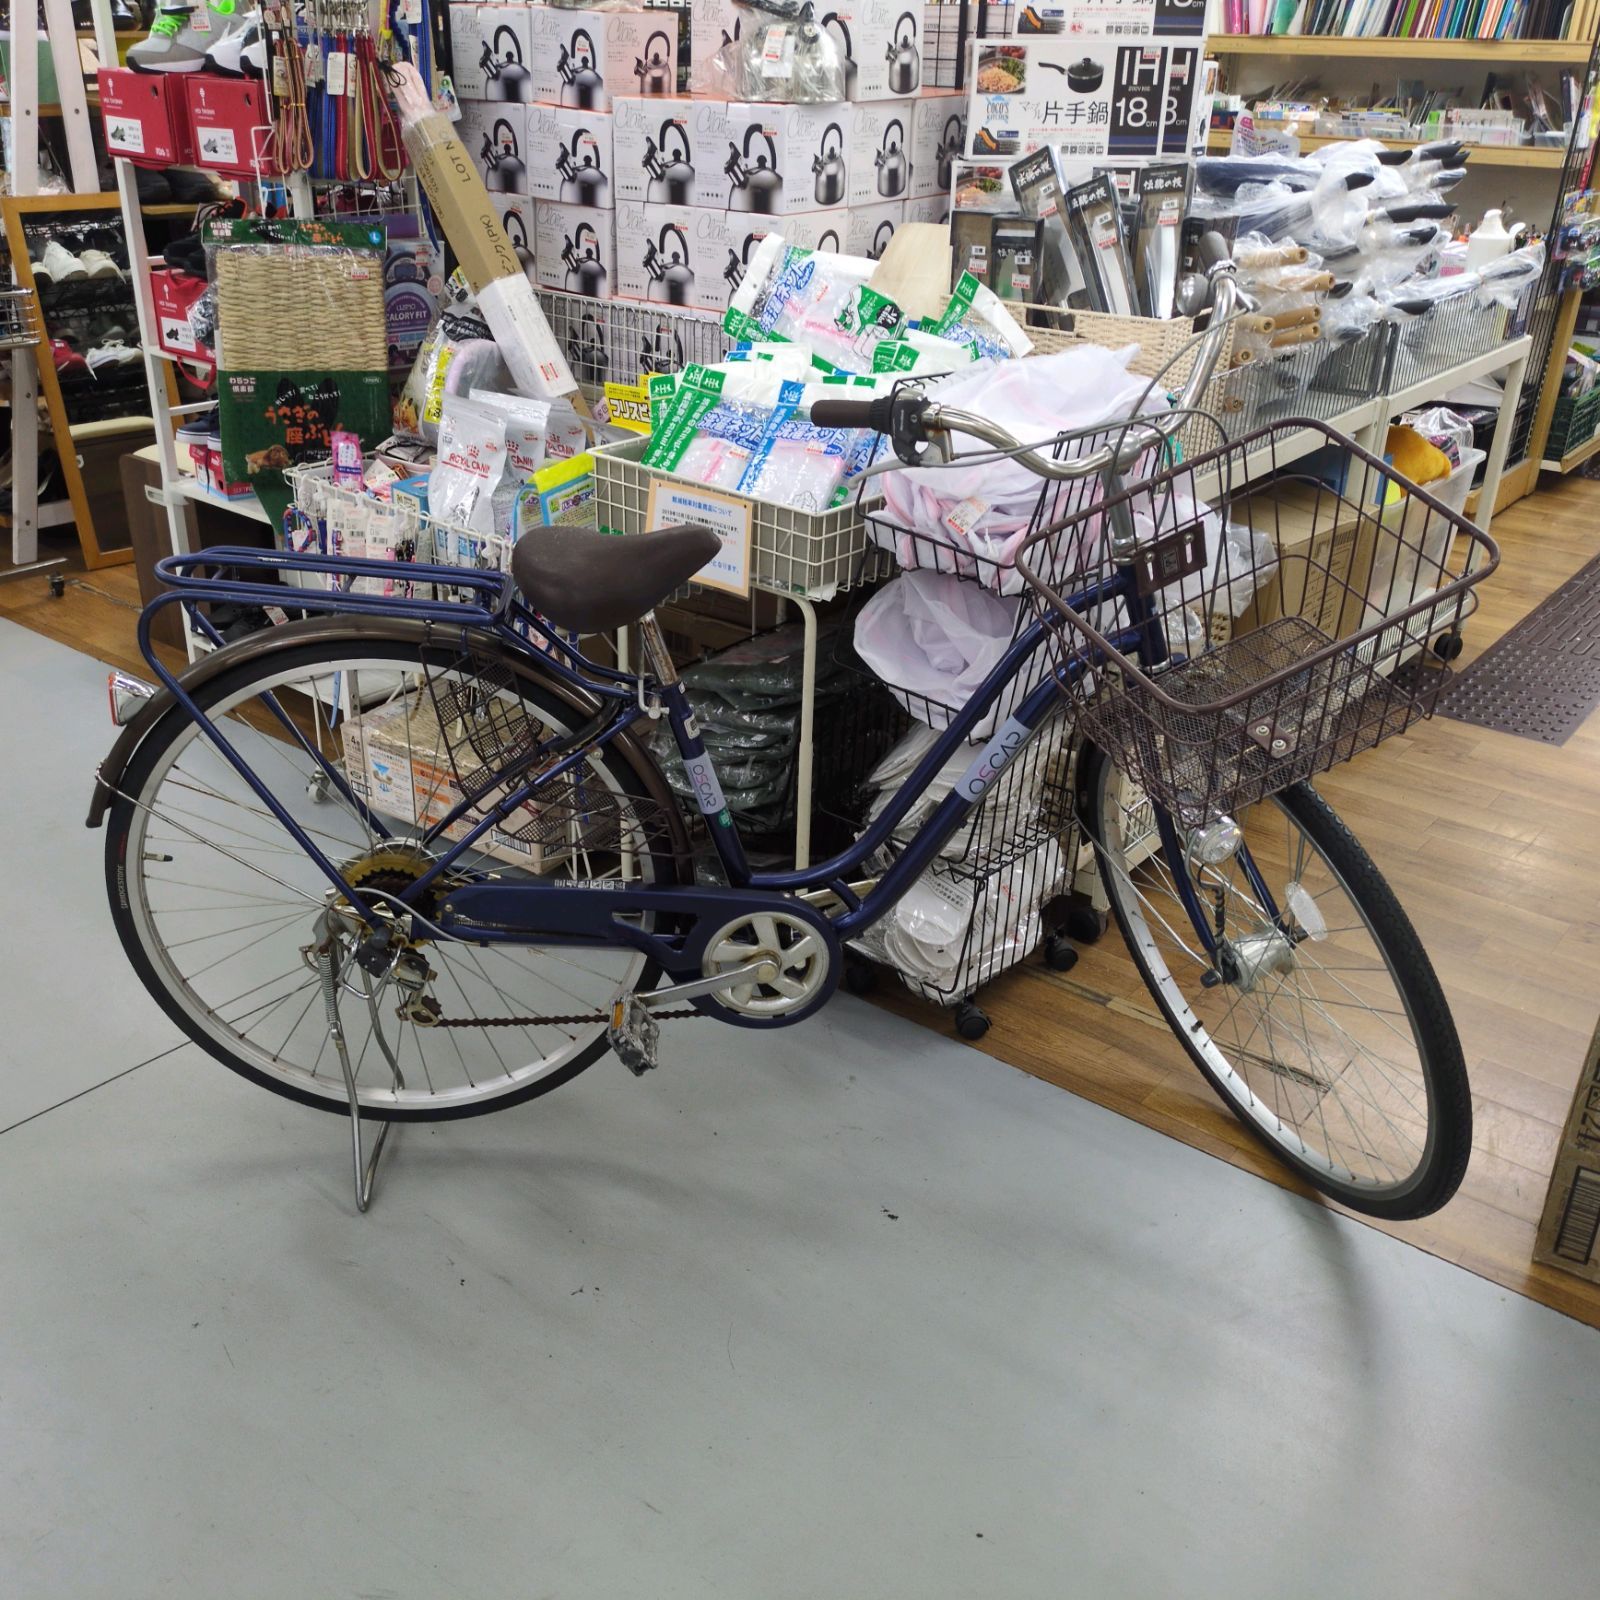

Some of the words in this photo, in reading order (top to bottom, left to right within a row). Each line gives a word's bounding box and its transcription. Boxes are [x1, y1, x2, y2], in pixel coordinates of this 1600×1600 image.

[1121, 49, 1161, 86] IH
[1042, 101, 1109, 125] 片手鍋
[450, 153, 471, 183] LOT
[264, 404, 319, 425] うさぎの
[697, 411, 765, 446] 洗濯ネット
[773, 420, 847, 446] 洗濯ネット
[968, 731, 1024, 795] OSCAR
[692, 764, 717, 808] OSCAR
